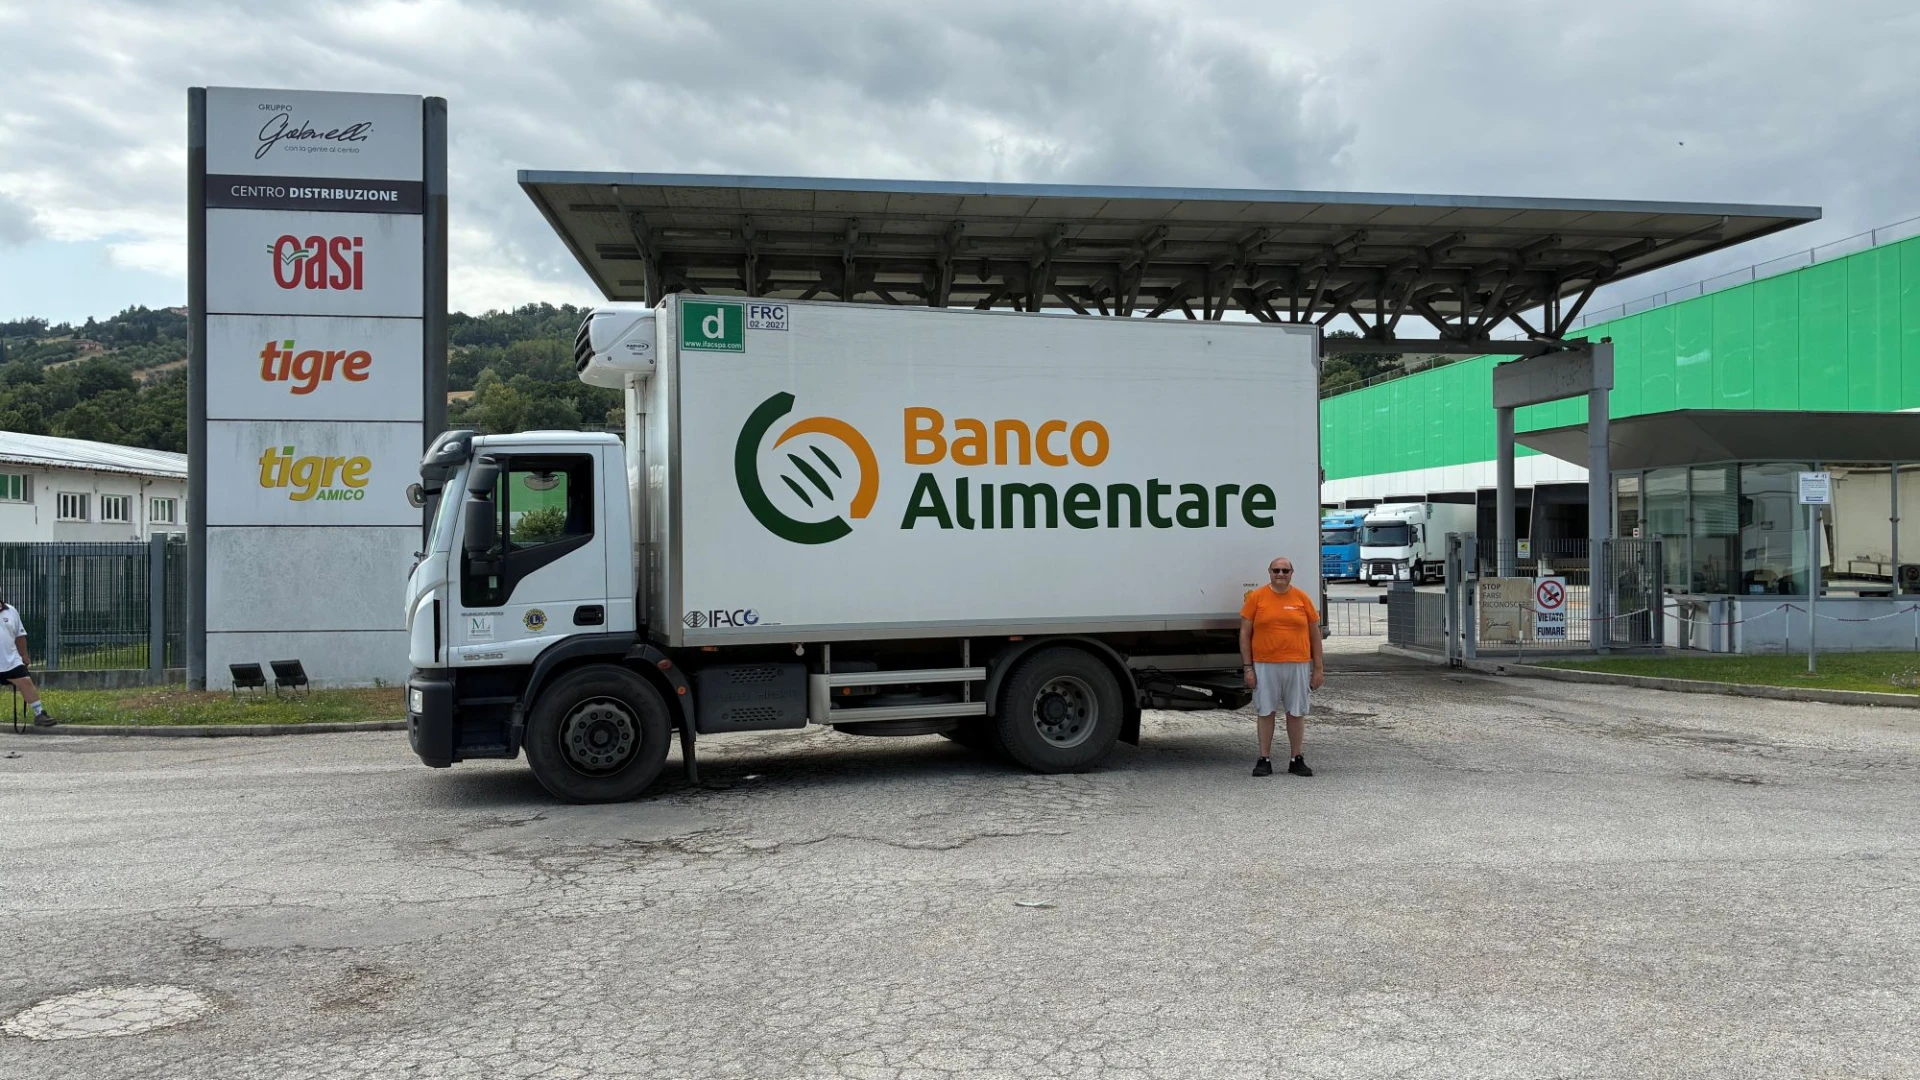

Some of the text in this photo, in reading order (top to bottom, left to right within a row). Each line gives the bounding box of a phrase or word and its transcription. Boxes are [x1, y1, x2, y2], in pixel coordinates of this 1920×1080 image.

[258, 103, 293, 112] GRUPPO
[307, 145, 328, 154] gente
[337, 146, 360, 154] centro
[230, 185, 398, 201] CENTRO DISTRIBUZIONE
[750, 306, 785, 320] FRC
[702, 308, 725, 339] d
[749, 320, 760, 328] 02
[765, 321, 785, 329] 2027
[684, 340, 742, 349] www.ifacspa.com
[259, 340, 372, 395] tigre
[904, 406, 1110, 468] Banco
[258, 446, 372, 501] tigre
[316, 489, 365, 501] AMICO
[900, 472, 1277, 530] Alimentare
[1537, 612, 1564, 622] VIETATO
[1537, 626, 1565, 636] FUMARE
